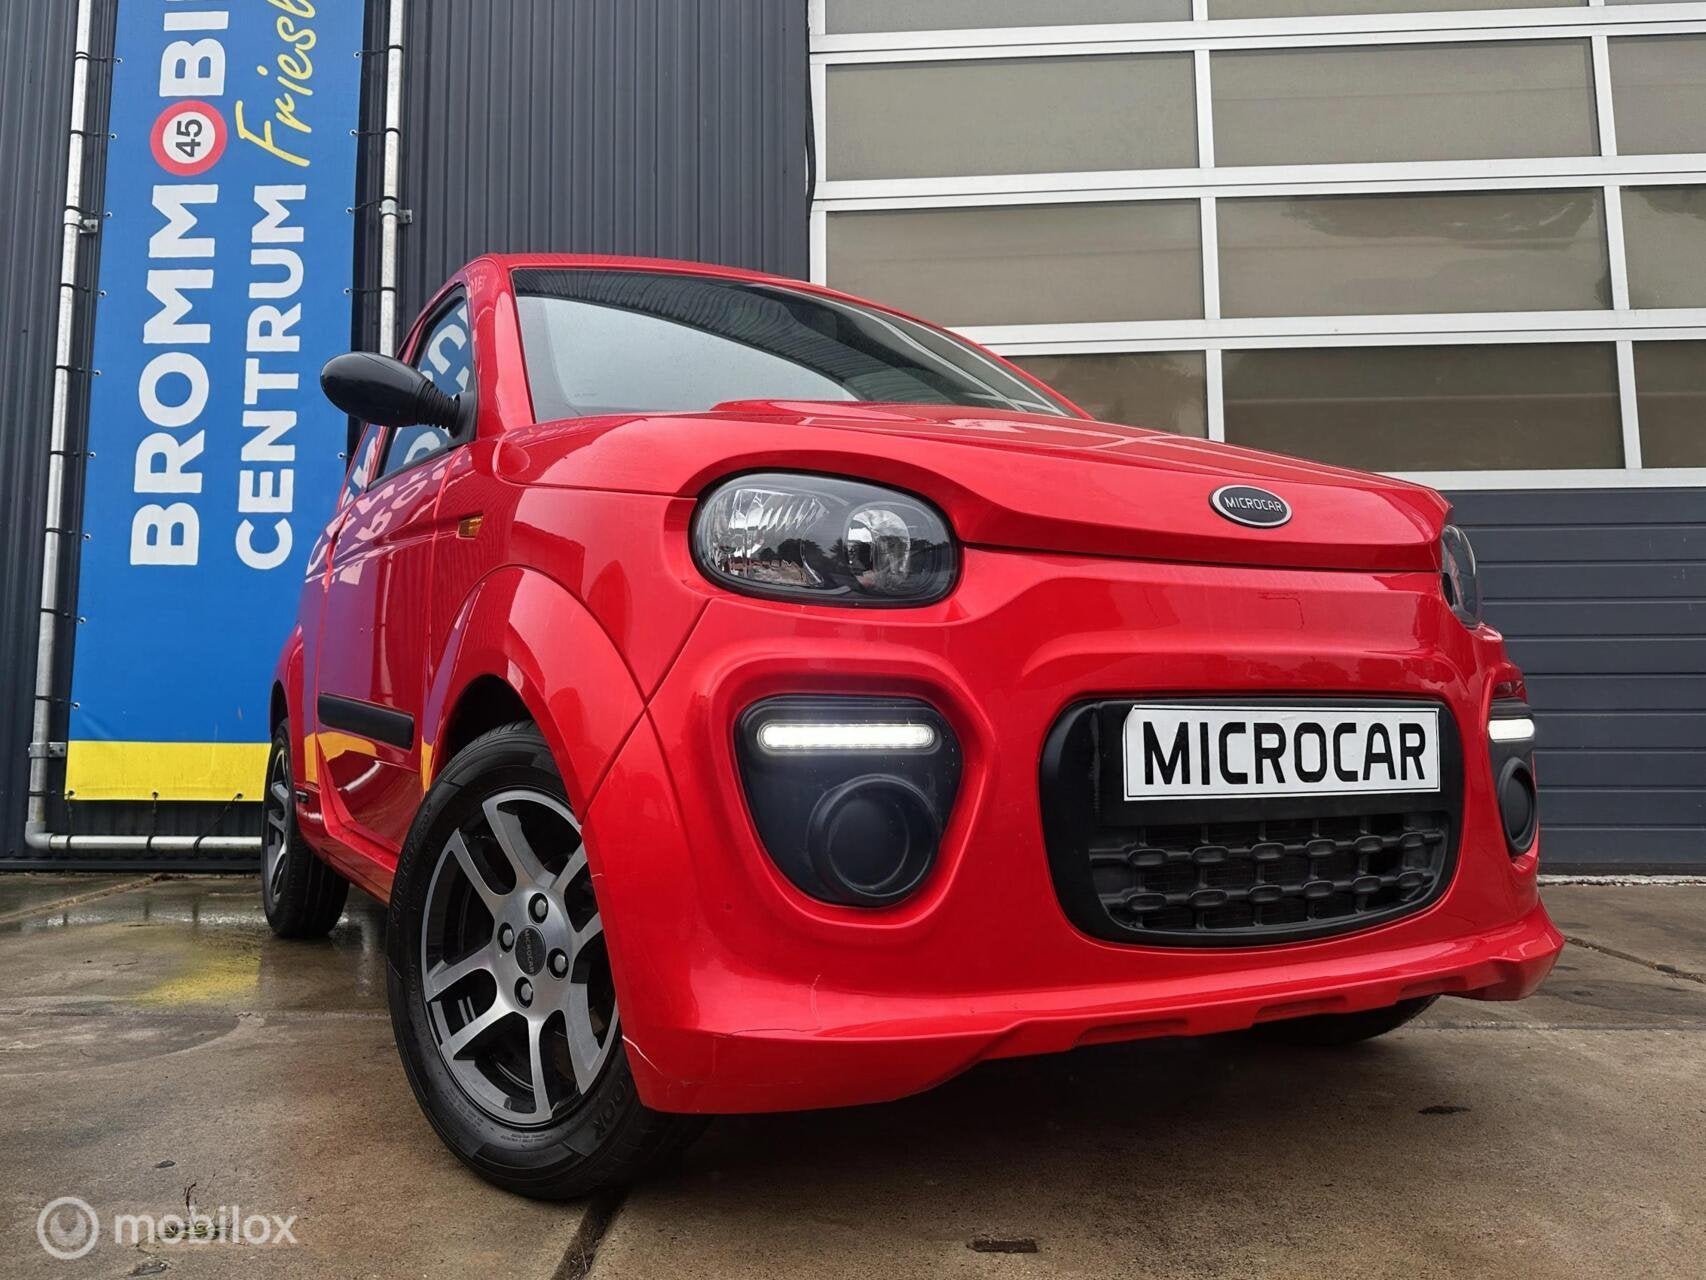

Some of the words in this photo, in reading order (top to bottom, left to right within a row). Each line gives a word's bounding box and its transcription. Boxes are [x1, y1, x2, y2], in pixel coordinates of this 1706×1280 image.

[159, 0, 229, 97] BI
[175, 119, 203, 158] 45
[130, 184, 219, 566] BROMM
[235, 184, 307, 571] CENTRUM
[1224, 496, 1283, 513] MICROCAR
[1142, 721, 1427, 786] MICROCAR
